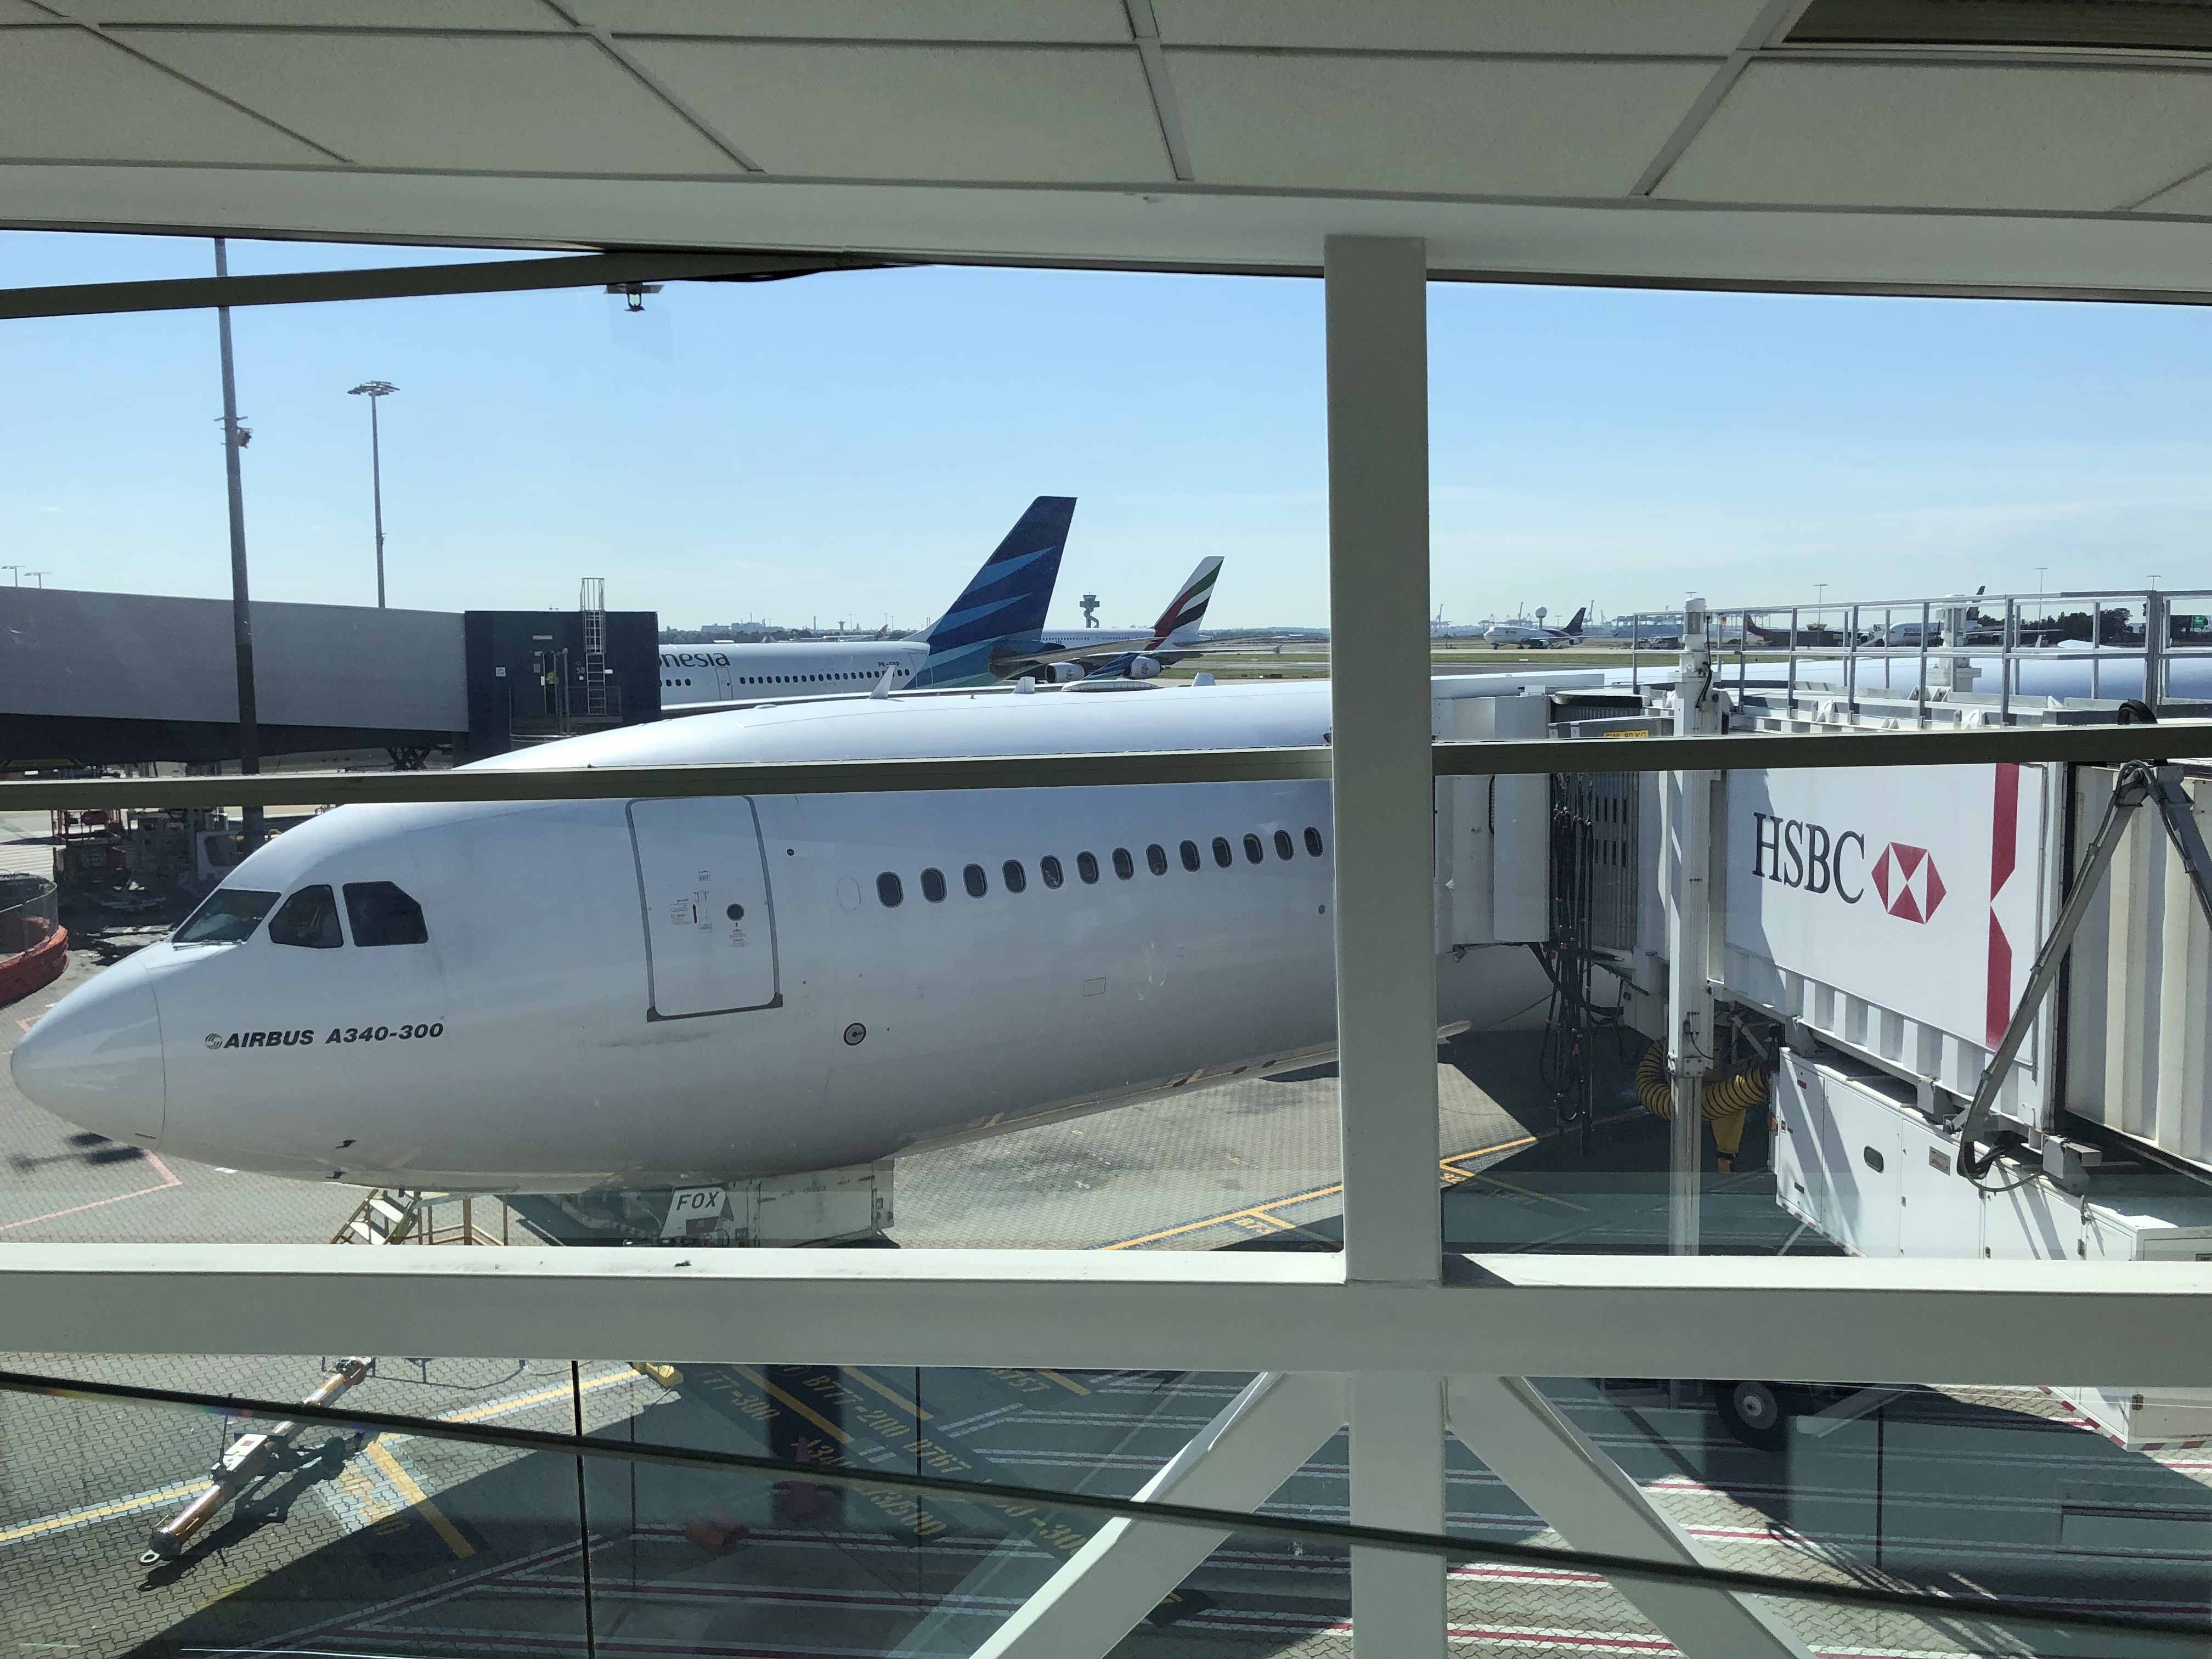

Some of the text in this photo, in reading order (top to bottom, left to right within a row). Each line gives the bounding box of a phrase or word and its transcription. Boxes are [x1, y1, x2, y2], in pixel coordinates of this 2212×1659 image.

[1752, 812, 1864, 904] HSBC
[223, 1023, 444, 1048] AIRBUS A340-300
[676, 1190, 720, 1211] FOX
